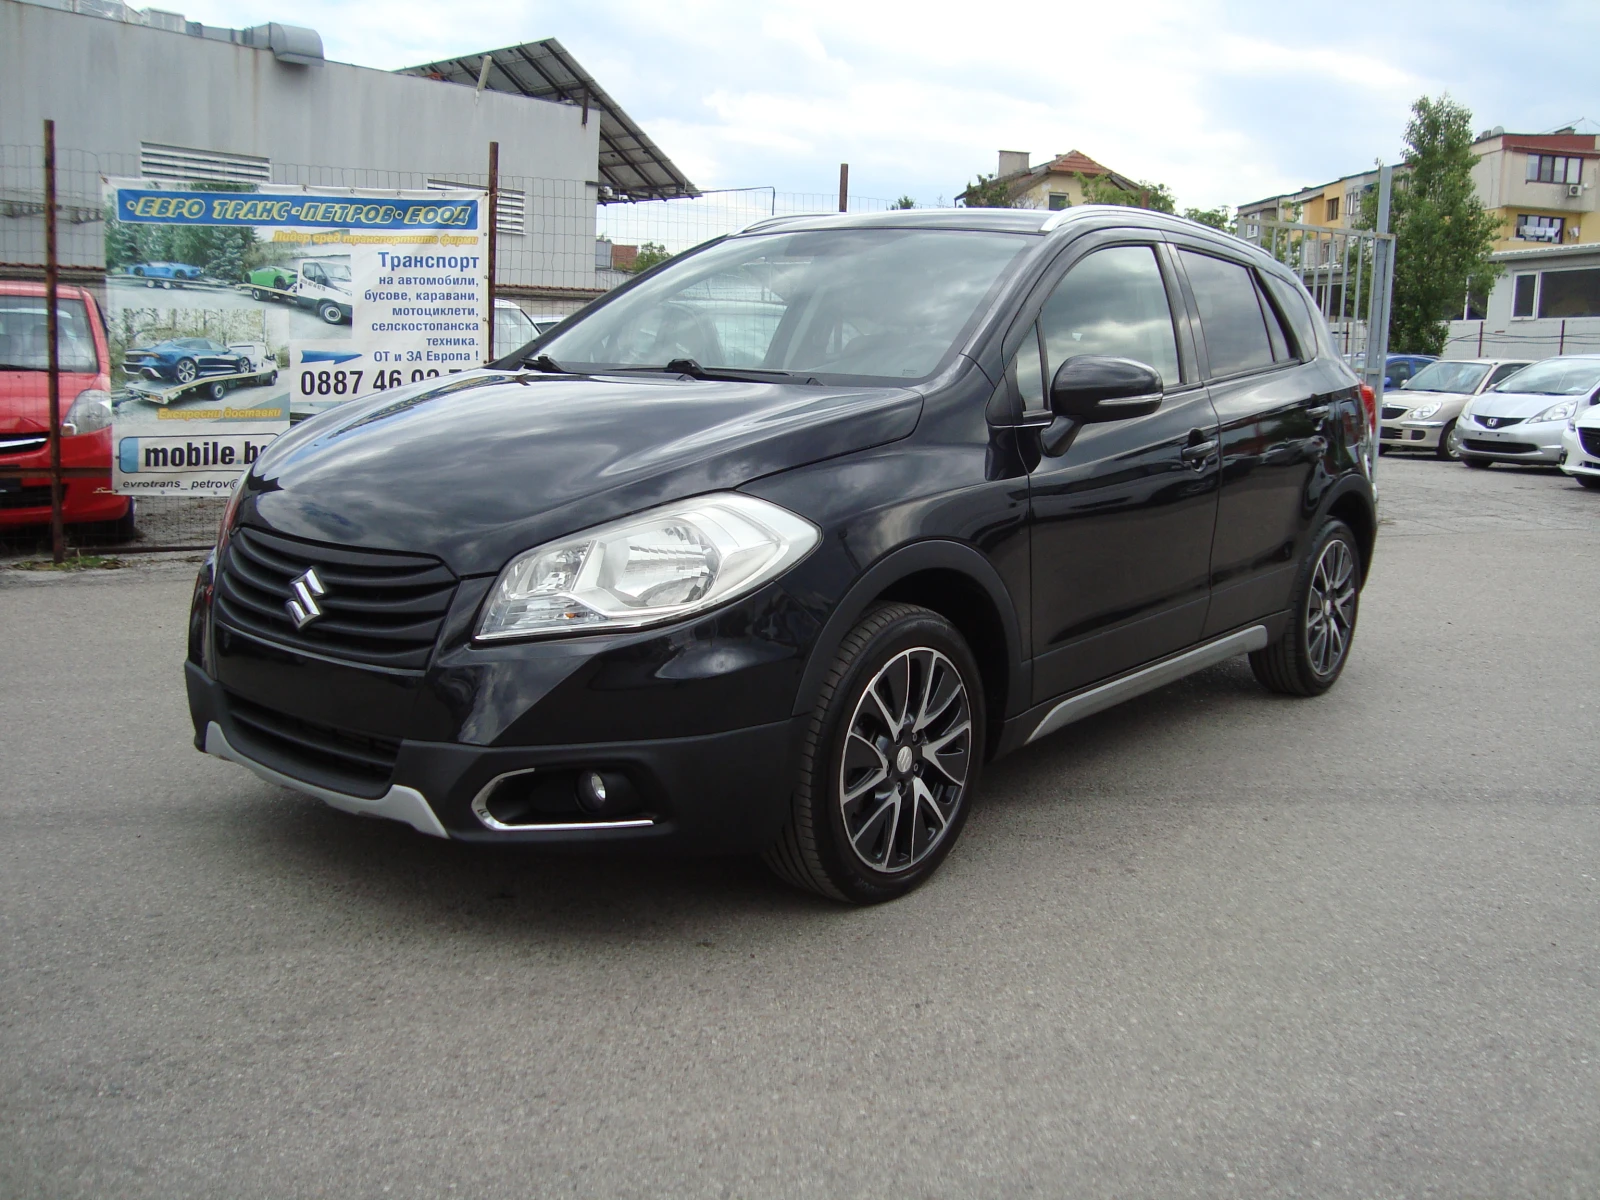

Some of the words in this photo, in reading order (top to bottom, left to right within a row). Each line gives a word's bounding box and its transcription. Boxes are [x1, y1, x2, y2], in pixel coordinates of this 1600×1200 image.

[273, 230, 312, 246] Лидер
[312, 231, 341, 246] сред
[342, 235, 438, 247] транспортните
[440, 235, 479, 247] фирми
[378, 251, 480, 273] Транспорт
[379, 276, 394, 285] на
[397, 274, 479, 287] автомобили,
[364, 289, 411, 302] бусове,
[416, 292, 479, 303] каравани,
[392, 307, 479, 318] мотоциклети,
[371, 321, 479, 332] селскостопанска
[426, 337, 479, 346] техника.
[373, 351, 390, 362] ОТ
[394, 353, 402, 361] и
[406, 351, 423, 362] ЗА
[426, 351, 471, 363] Европа
[301, 370, 364, 396] 0887
[373, 369, 402, 391] 46
[157, 407, 221, 421] Експресни
[224, 407, 283, 418] доставки
[144, 440, 268, 467] mobile.b
[122, 479, 188, 491] evrotrans_
